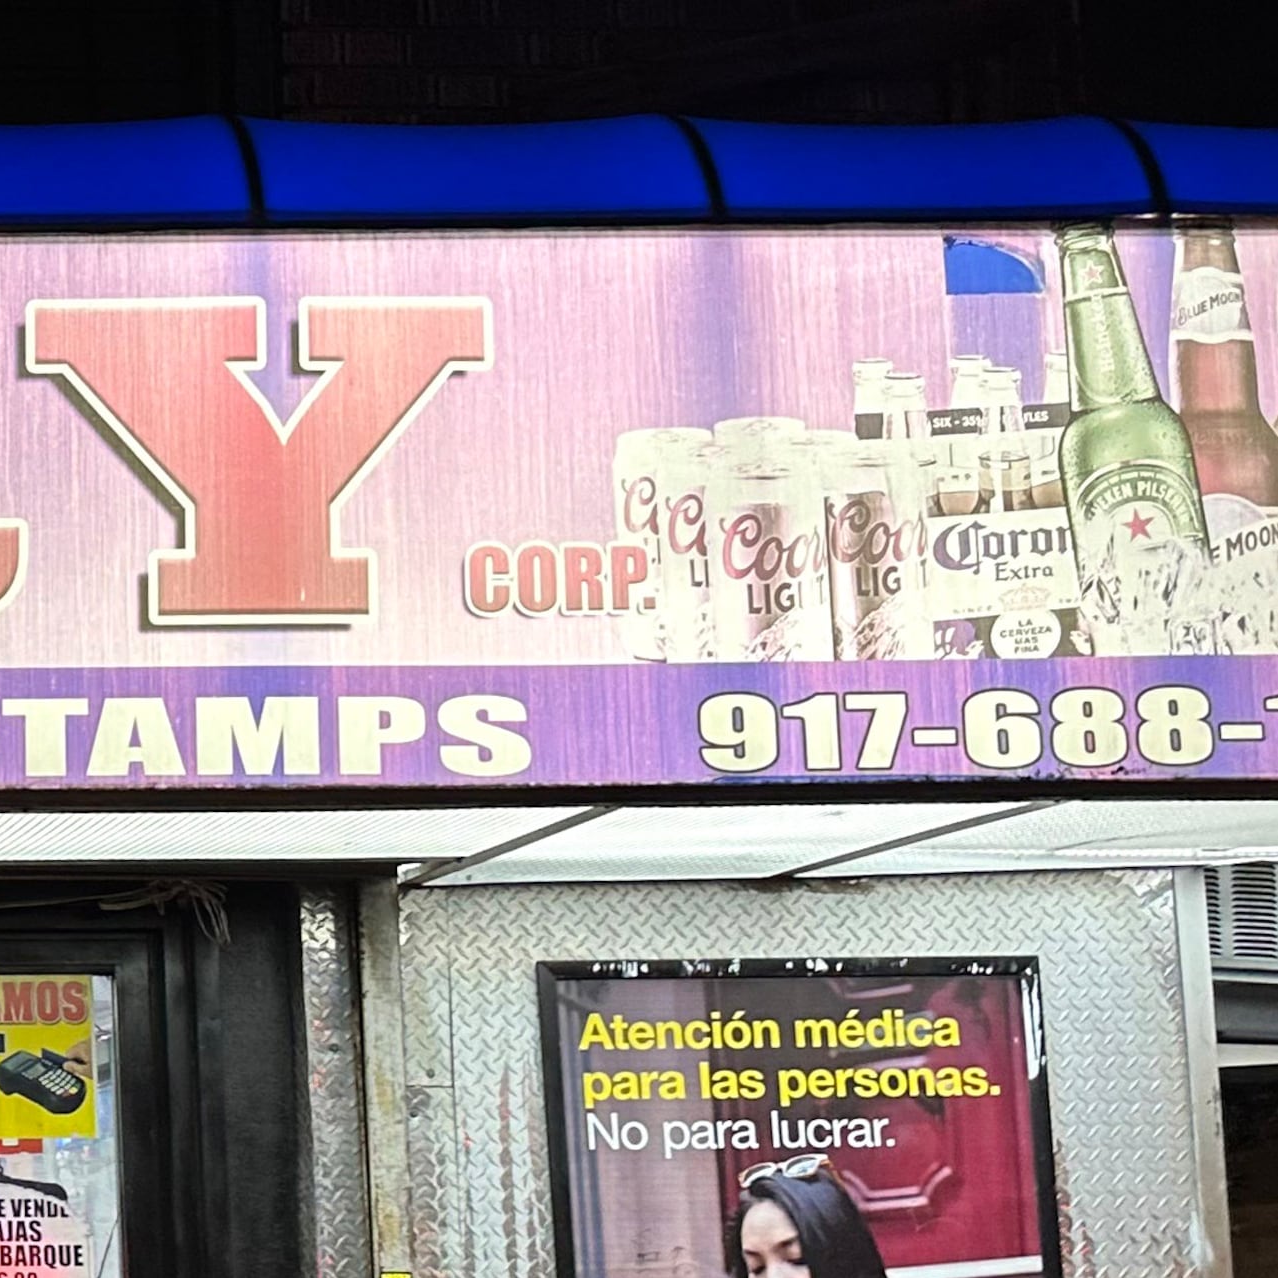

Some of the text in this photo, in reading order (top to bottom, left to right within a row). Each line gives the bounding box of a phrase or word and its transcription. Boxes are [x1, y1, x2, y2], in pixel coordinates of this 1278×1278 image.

[466, 542, 657, 614] CORP.
[994, 559, 1055, 582] Extra
[999, 625, 1053, 638] CERVEZA
[1018, 618, 1033, 627] LA
[697, 684, 1278, 774] 917-688-
[579, 1009, 960, 1051] Atención médica
[583, 1062, 1001, 1108] para las personas.
[586, 1109, 897, 1159] No para lucrar.
